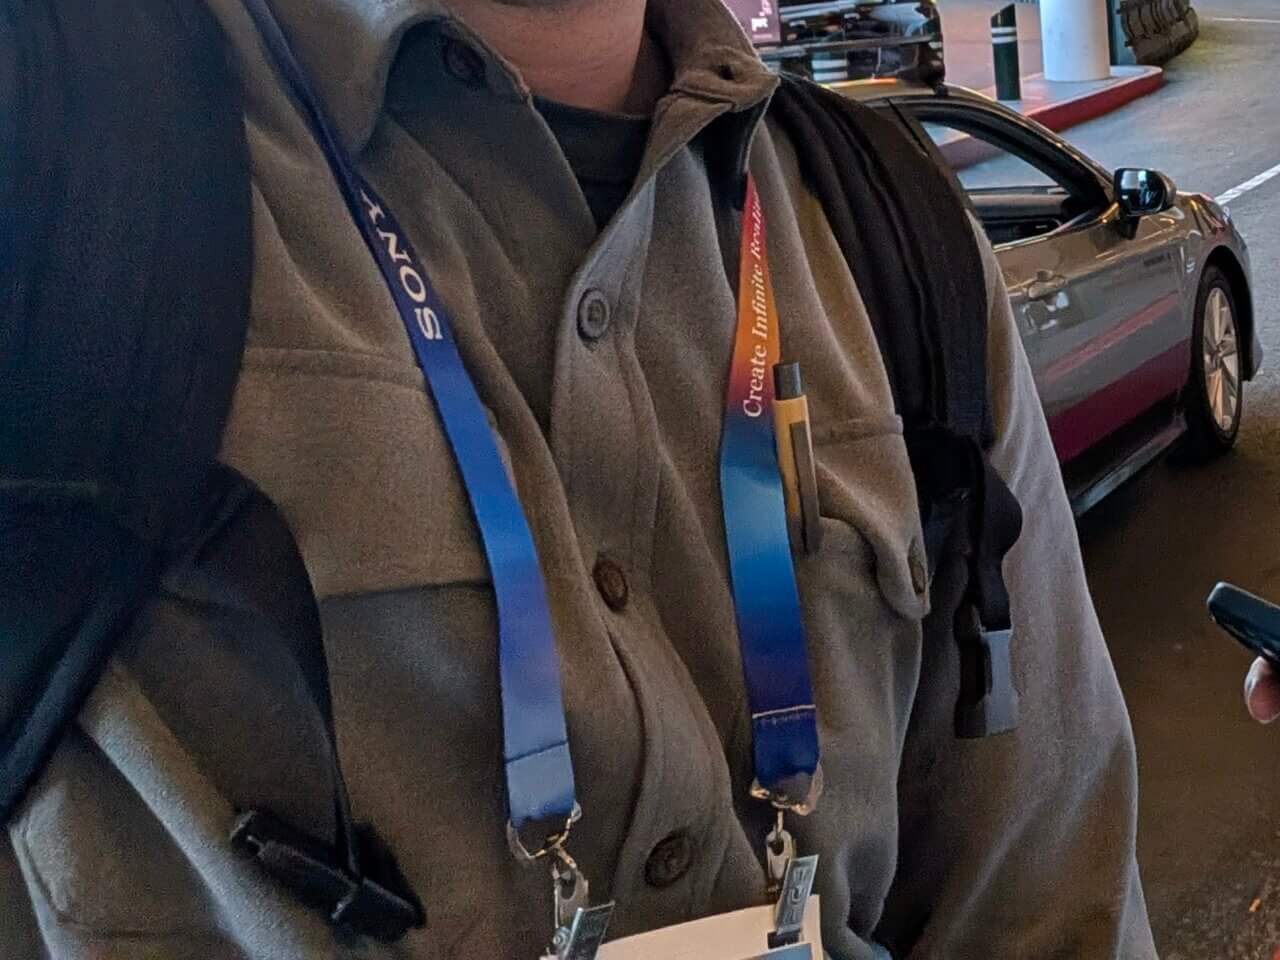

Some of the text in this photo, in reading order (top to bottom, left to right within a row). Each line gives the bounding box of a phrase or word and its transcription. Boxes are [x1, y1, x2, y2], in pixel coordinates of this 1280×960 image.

[360, 188, 443, 340] SONY
[751, 264, 769, 340] Infinite
[743, 344, 767, 418] Create
